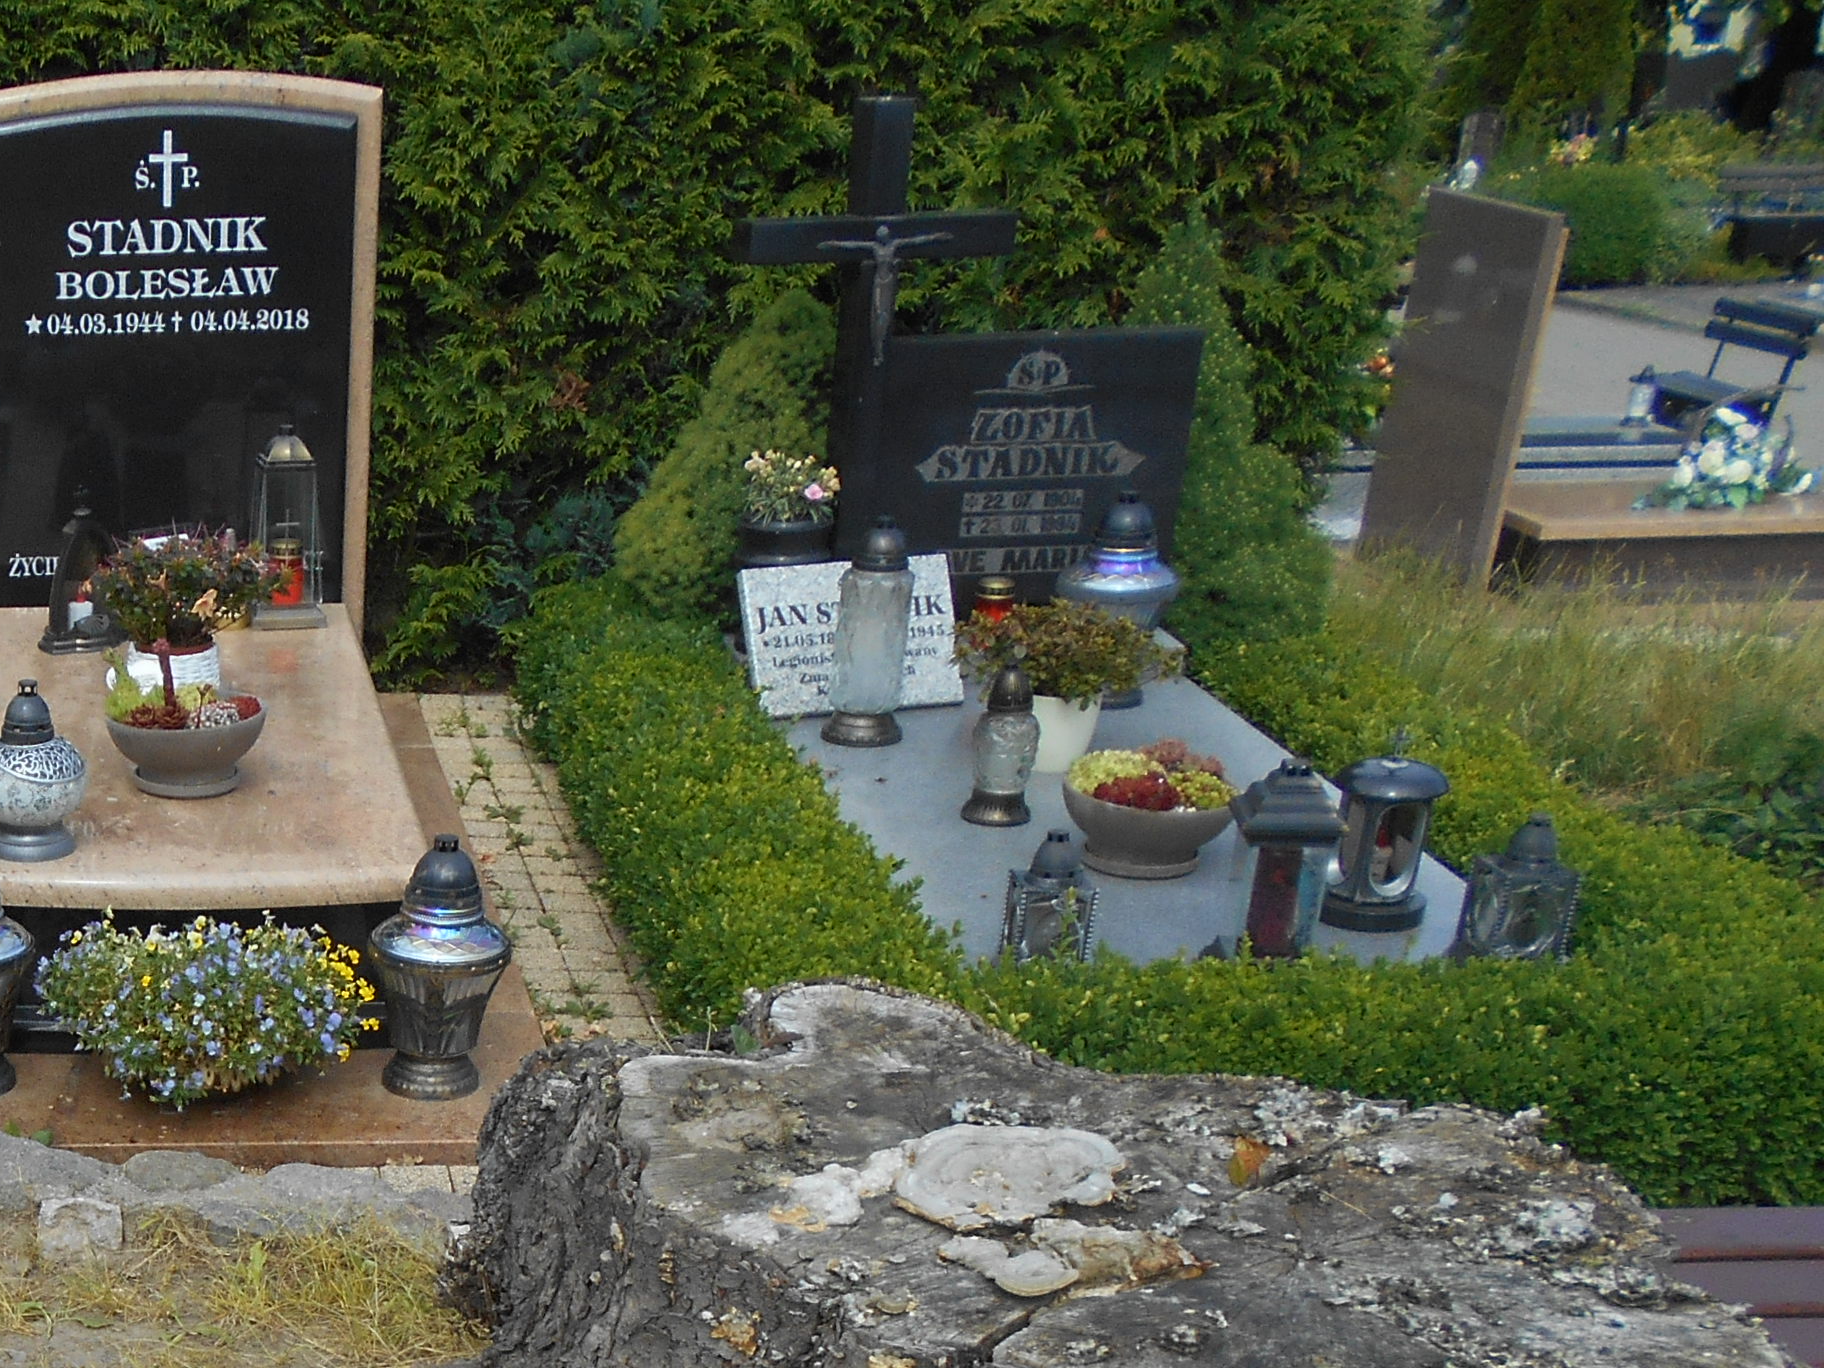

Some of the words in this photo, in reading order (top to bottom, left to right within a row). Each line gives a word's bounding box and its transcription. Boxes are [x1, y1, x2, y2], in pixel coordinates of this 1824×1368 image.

[66, 216, 268, 258] STADNIK
[55, 266, 280, 301] BOLESŁAW
[46, 311, 166, 335] 04.03.1944
[190, 308, 310, 333] 04.04.2018
[973, 408, 1095, 442] ZOFIA
[934, 446, 1119, 478] STADNIK
[950, 550, 987, 573] VE
[756, 604, 809, 635] JAN
[772, 650, 836, 670] Legionis
